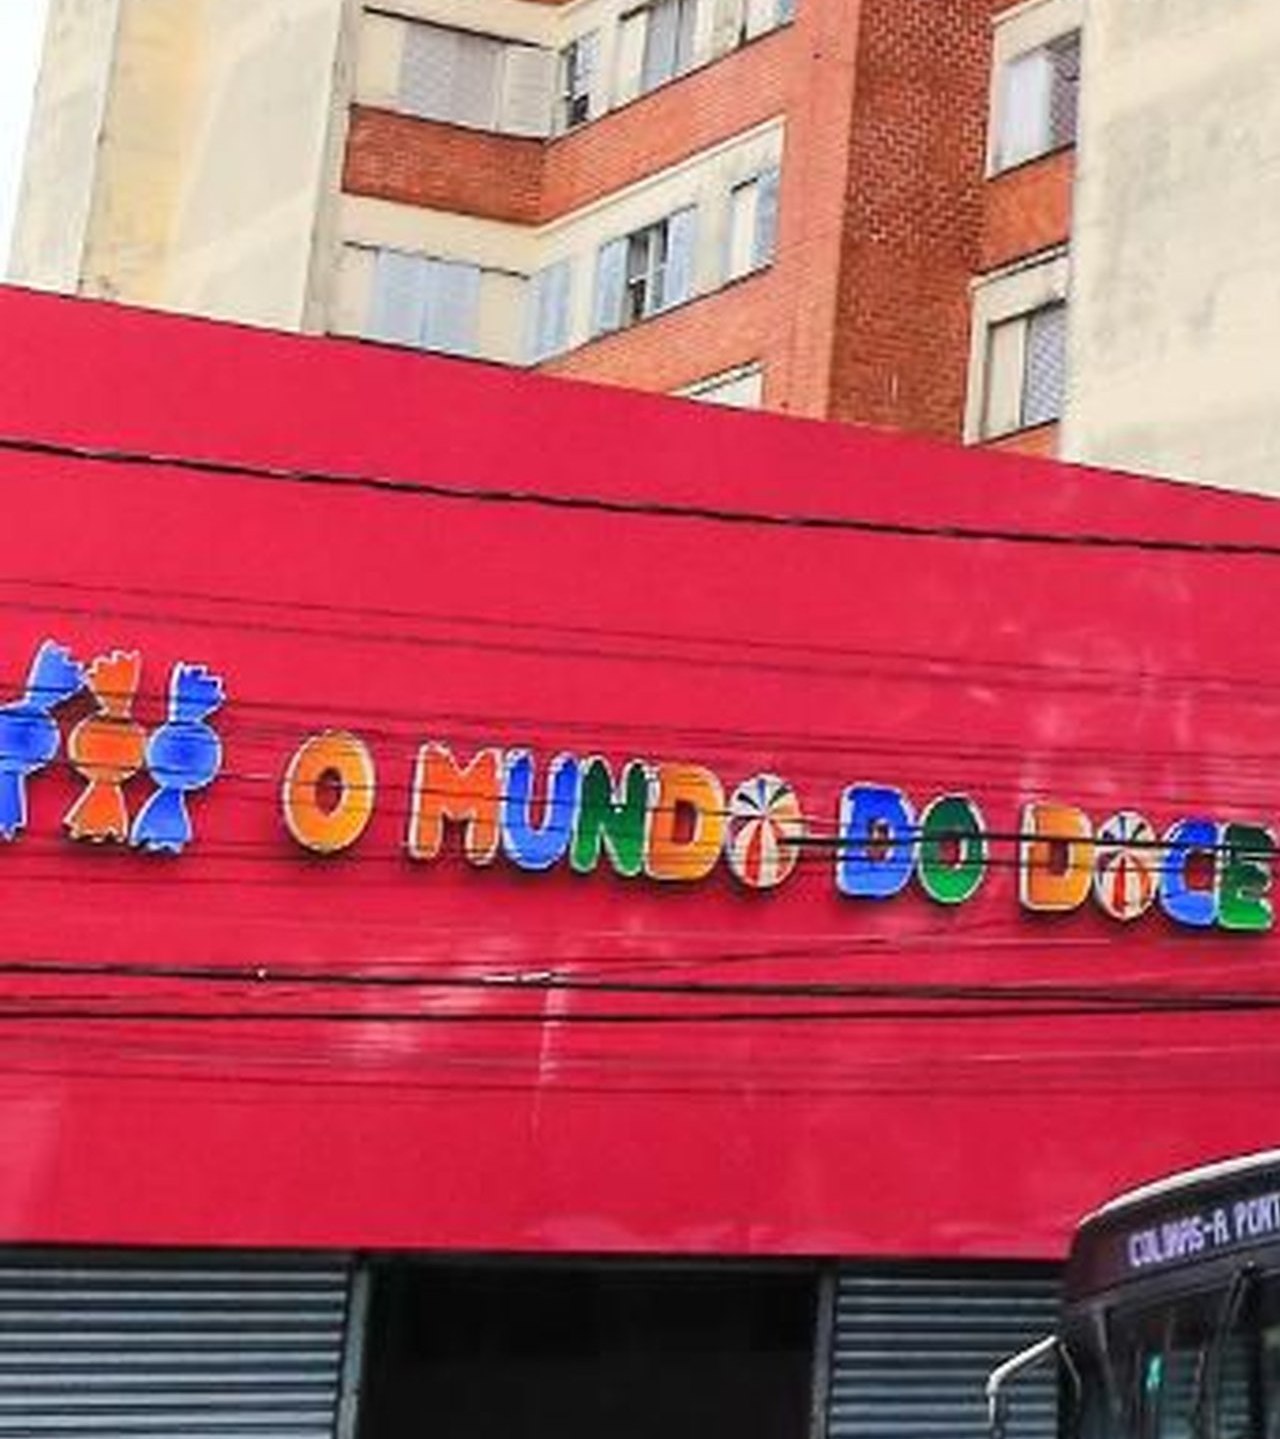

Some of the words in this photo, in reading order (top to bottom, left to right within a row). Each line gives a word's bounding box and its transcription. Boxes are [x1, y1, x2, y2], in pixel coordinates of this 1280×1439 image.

[282, 729, 376, 853] O
[408, 740, 802, 889] MUNDO
[836, 781, 987, 904] DO
[1019, 799, 1278, 931] DOCE
